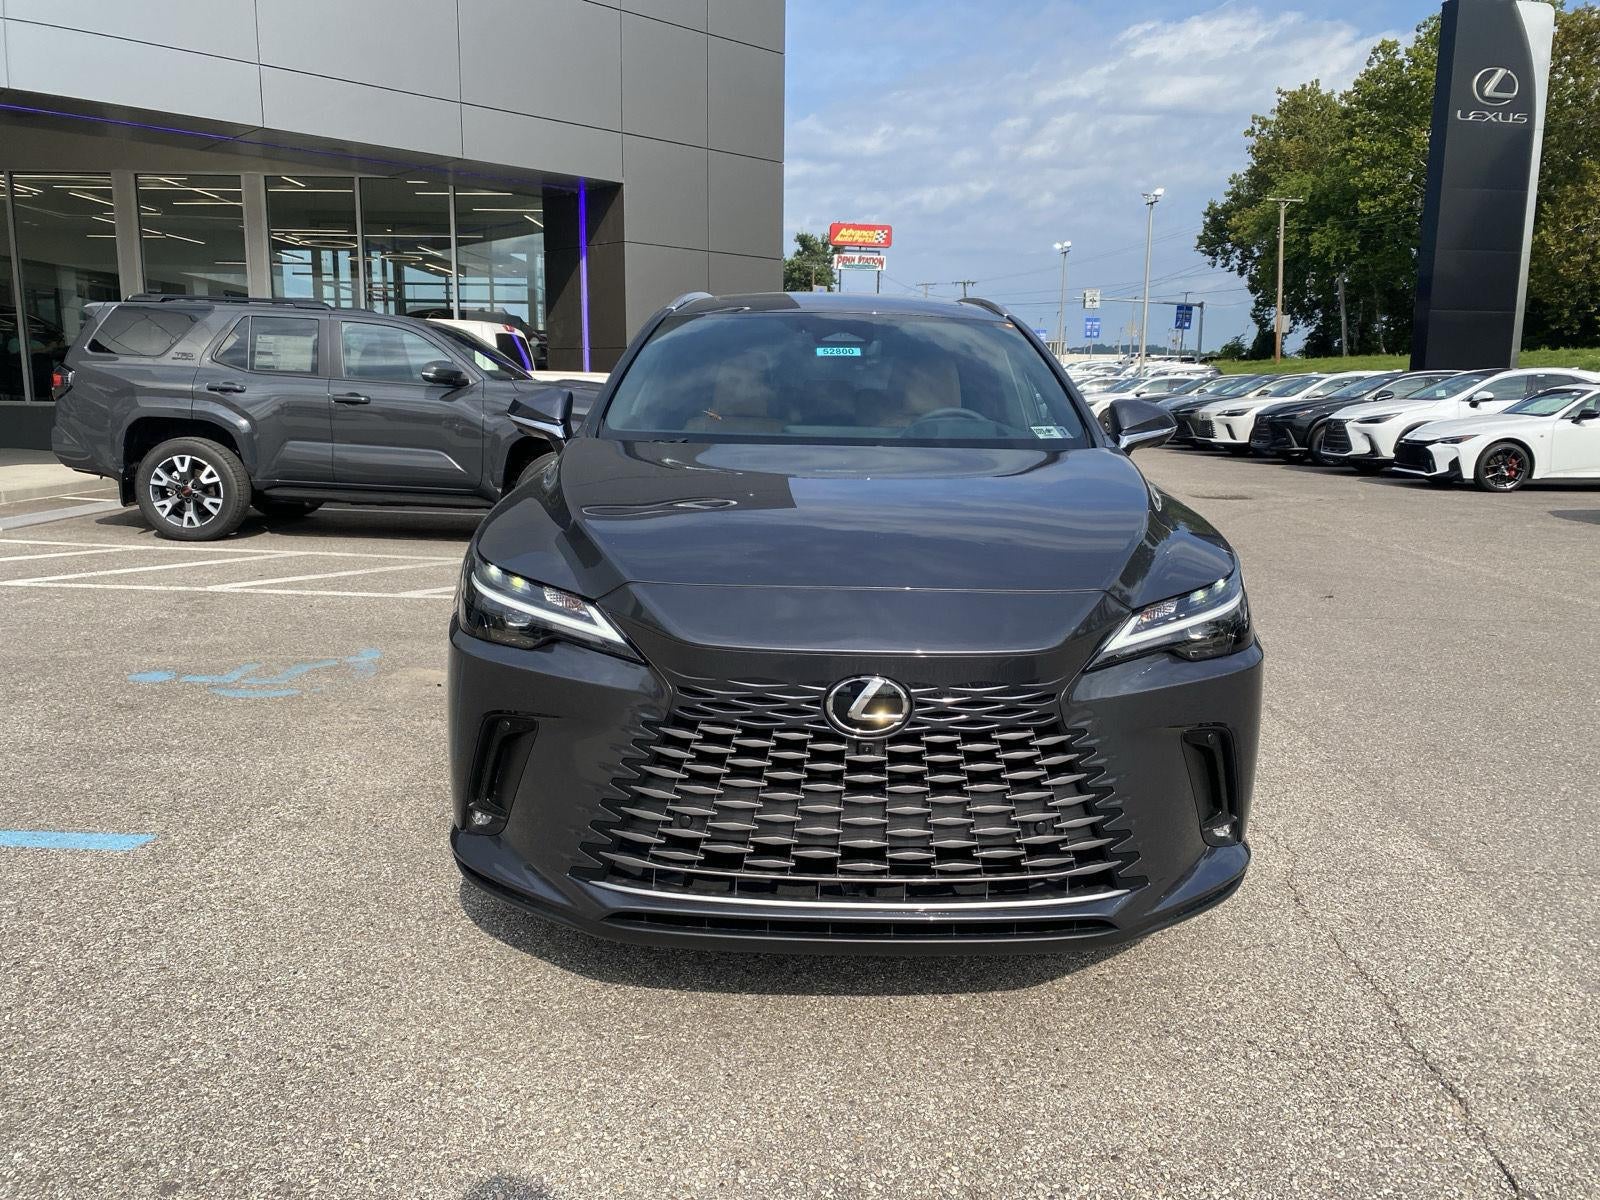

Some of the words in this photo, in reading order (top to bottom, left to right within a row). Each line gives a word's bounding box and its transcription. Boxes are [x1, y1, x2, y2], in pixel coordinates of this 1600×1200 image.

[1456, 109, 1528, 124] LEXUS
[839, 228, 875, 236] Advance
[834, 234, 853, 242] Auto
[837, 255, 856, 269] PENN
[857, 255, 884, 269] STATION
